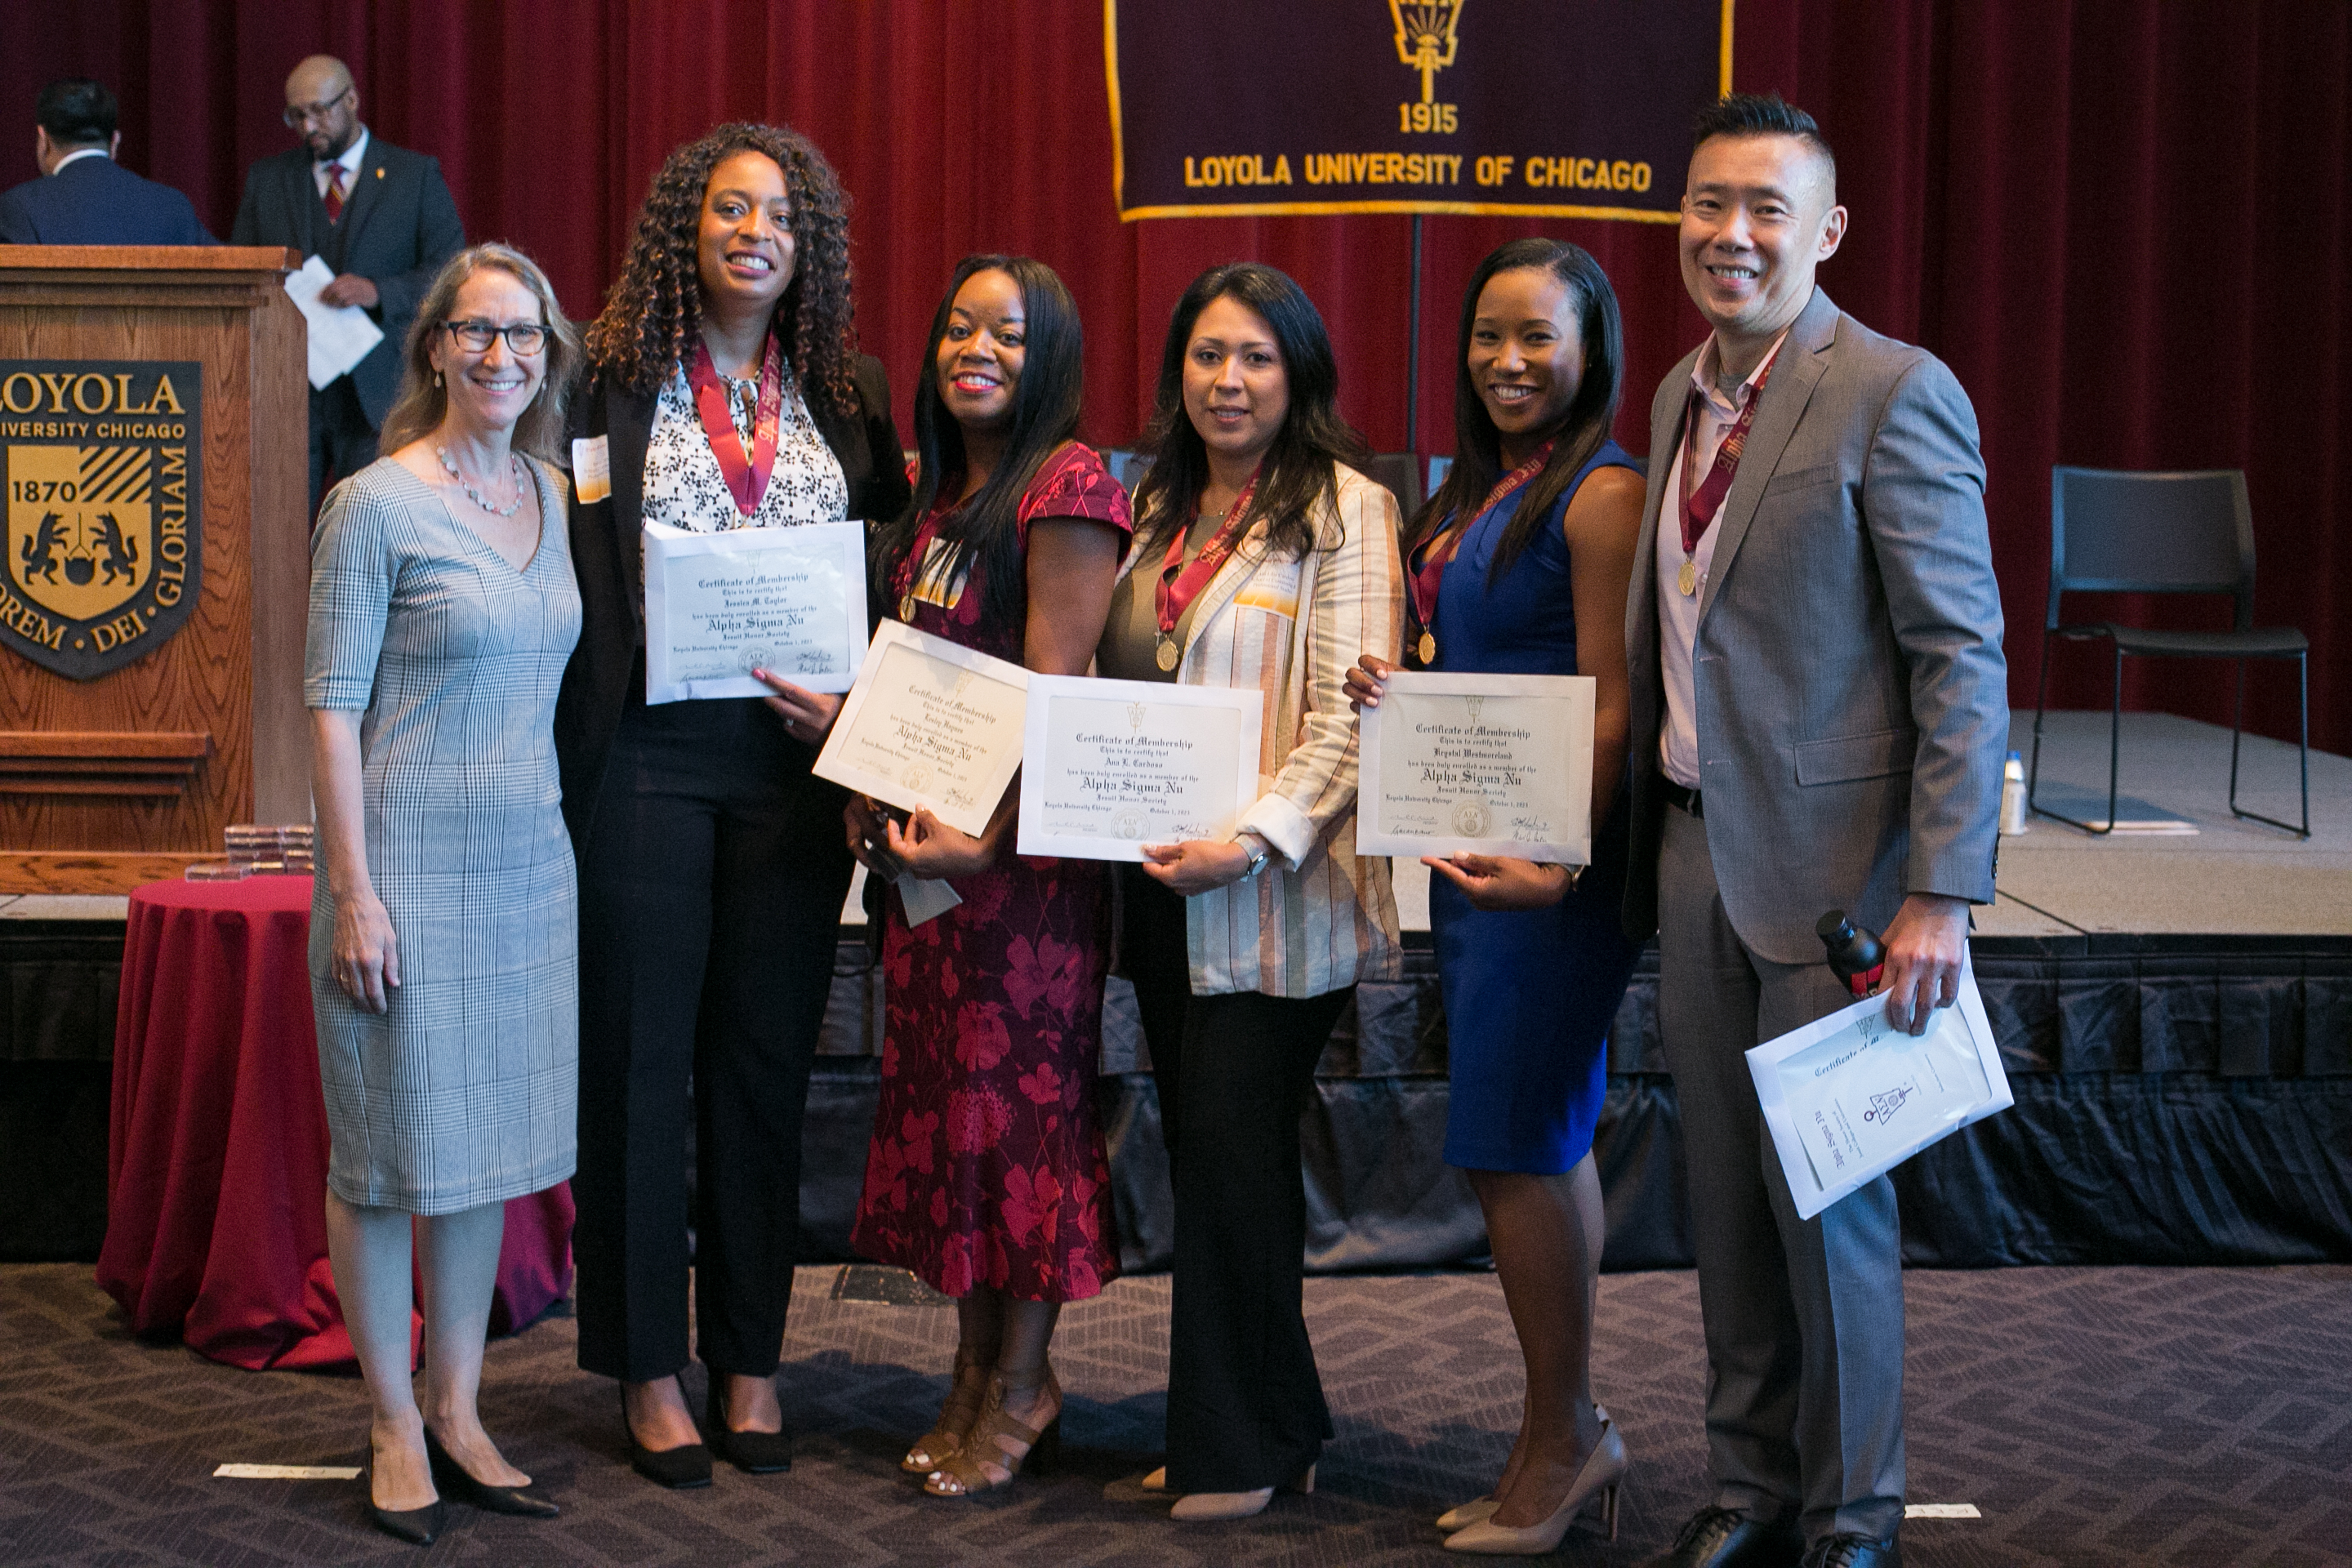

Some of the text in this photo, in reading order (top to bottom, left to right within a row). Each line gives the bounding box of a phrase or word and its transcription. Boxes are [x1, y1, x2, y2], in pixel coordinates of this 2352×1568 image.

[1399, 102, 1459, 134] 1915
[1184, 154, 1652, 193] LOYOLA UNIVERSITY OF CHICAGO
[0, 372, 186, 415] OYOLA
[97, 422, 186, 439] CHICAGO
[1717, 432, 1747, 476] Alpha
[13, 481, 77, 503] 1870
[90, 609, 148, 653] DEI
[156, 446, 187, 606] GLORIAM
[698, 572, 808, 589] Certificate of Membership
[707, 614, 804, 633] Alpha Sigma Nu
[908, 685, 996, 724] Certificate of Membership
[1416, 723, 1530, 740] Certificate of Membership
[893, 724, 972, 762] Alpha Sigma Nu
[1076, 733, 1193, 751] Certificate of Membership
[1439, 736, 1454, 746] This
[1473, 739, 1493, 747] certify
[1495, 740, 1506, 748] that
[1100, 746, 1115, 755] This
[1134, 747, 1154, 757] certify
[1156, 749, 1169, 758] that
[1434, 747, 1513, 759] Krystal Westmoreland
[1408, 759, 1419, 768] has
[1437, 761, 1450, 769] duly
[1067, 768, 1078, 776] has
[1097, 770, 1110, 778] duly
[1189, 775, 1198, 783] the
[1420, 768, 1521, 787] Alpha Sigma Nu
[1080, 777, 1183, 797] Alpha Sigma Nu
[1437, 786, 1457, 794] Jesuit
[1482, 788, 1506, 798] Society
[1096, 794, 1116, 802] Jesuit
[1140, 797, 1167, 805] Society
[1815, 1041, 1867, 1077] Certificate of
[1815, 1110, 1845, 1169] Alpha Sigma Nu
